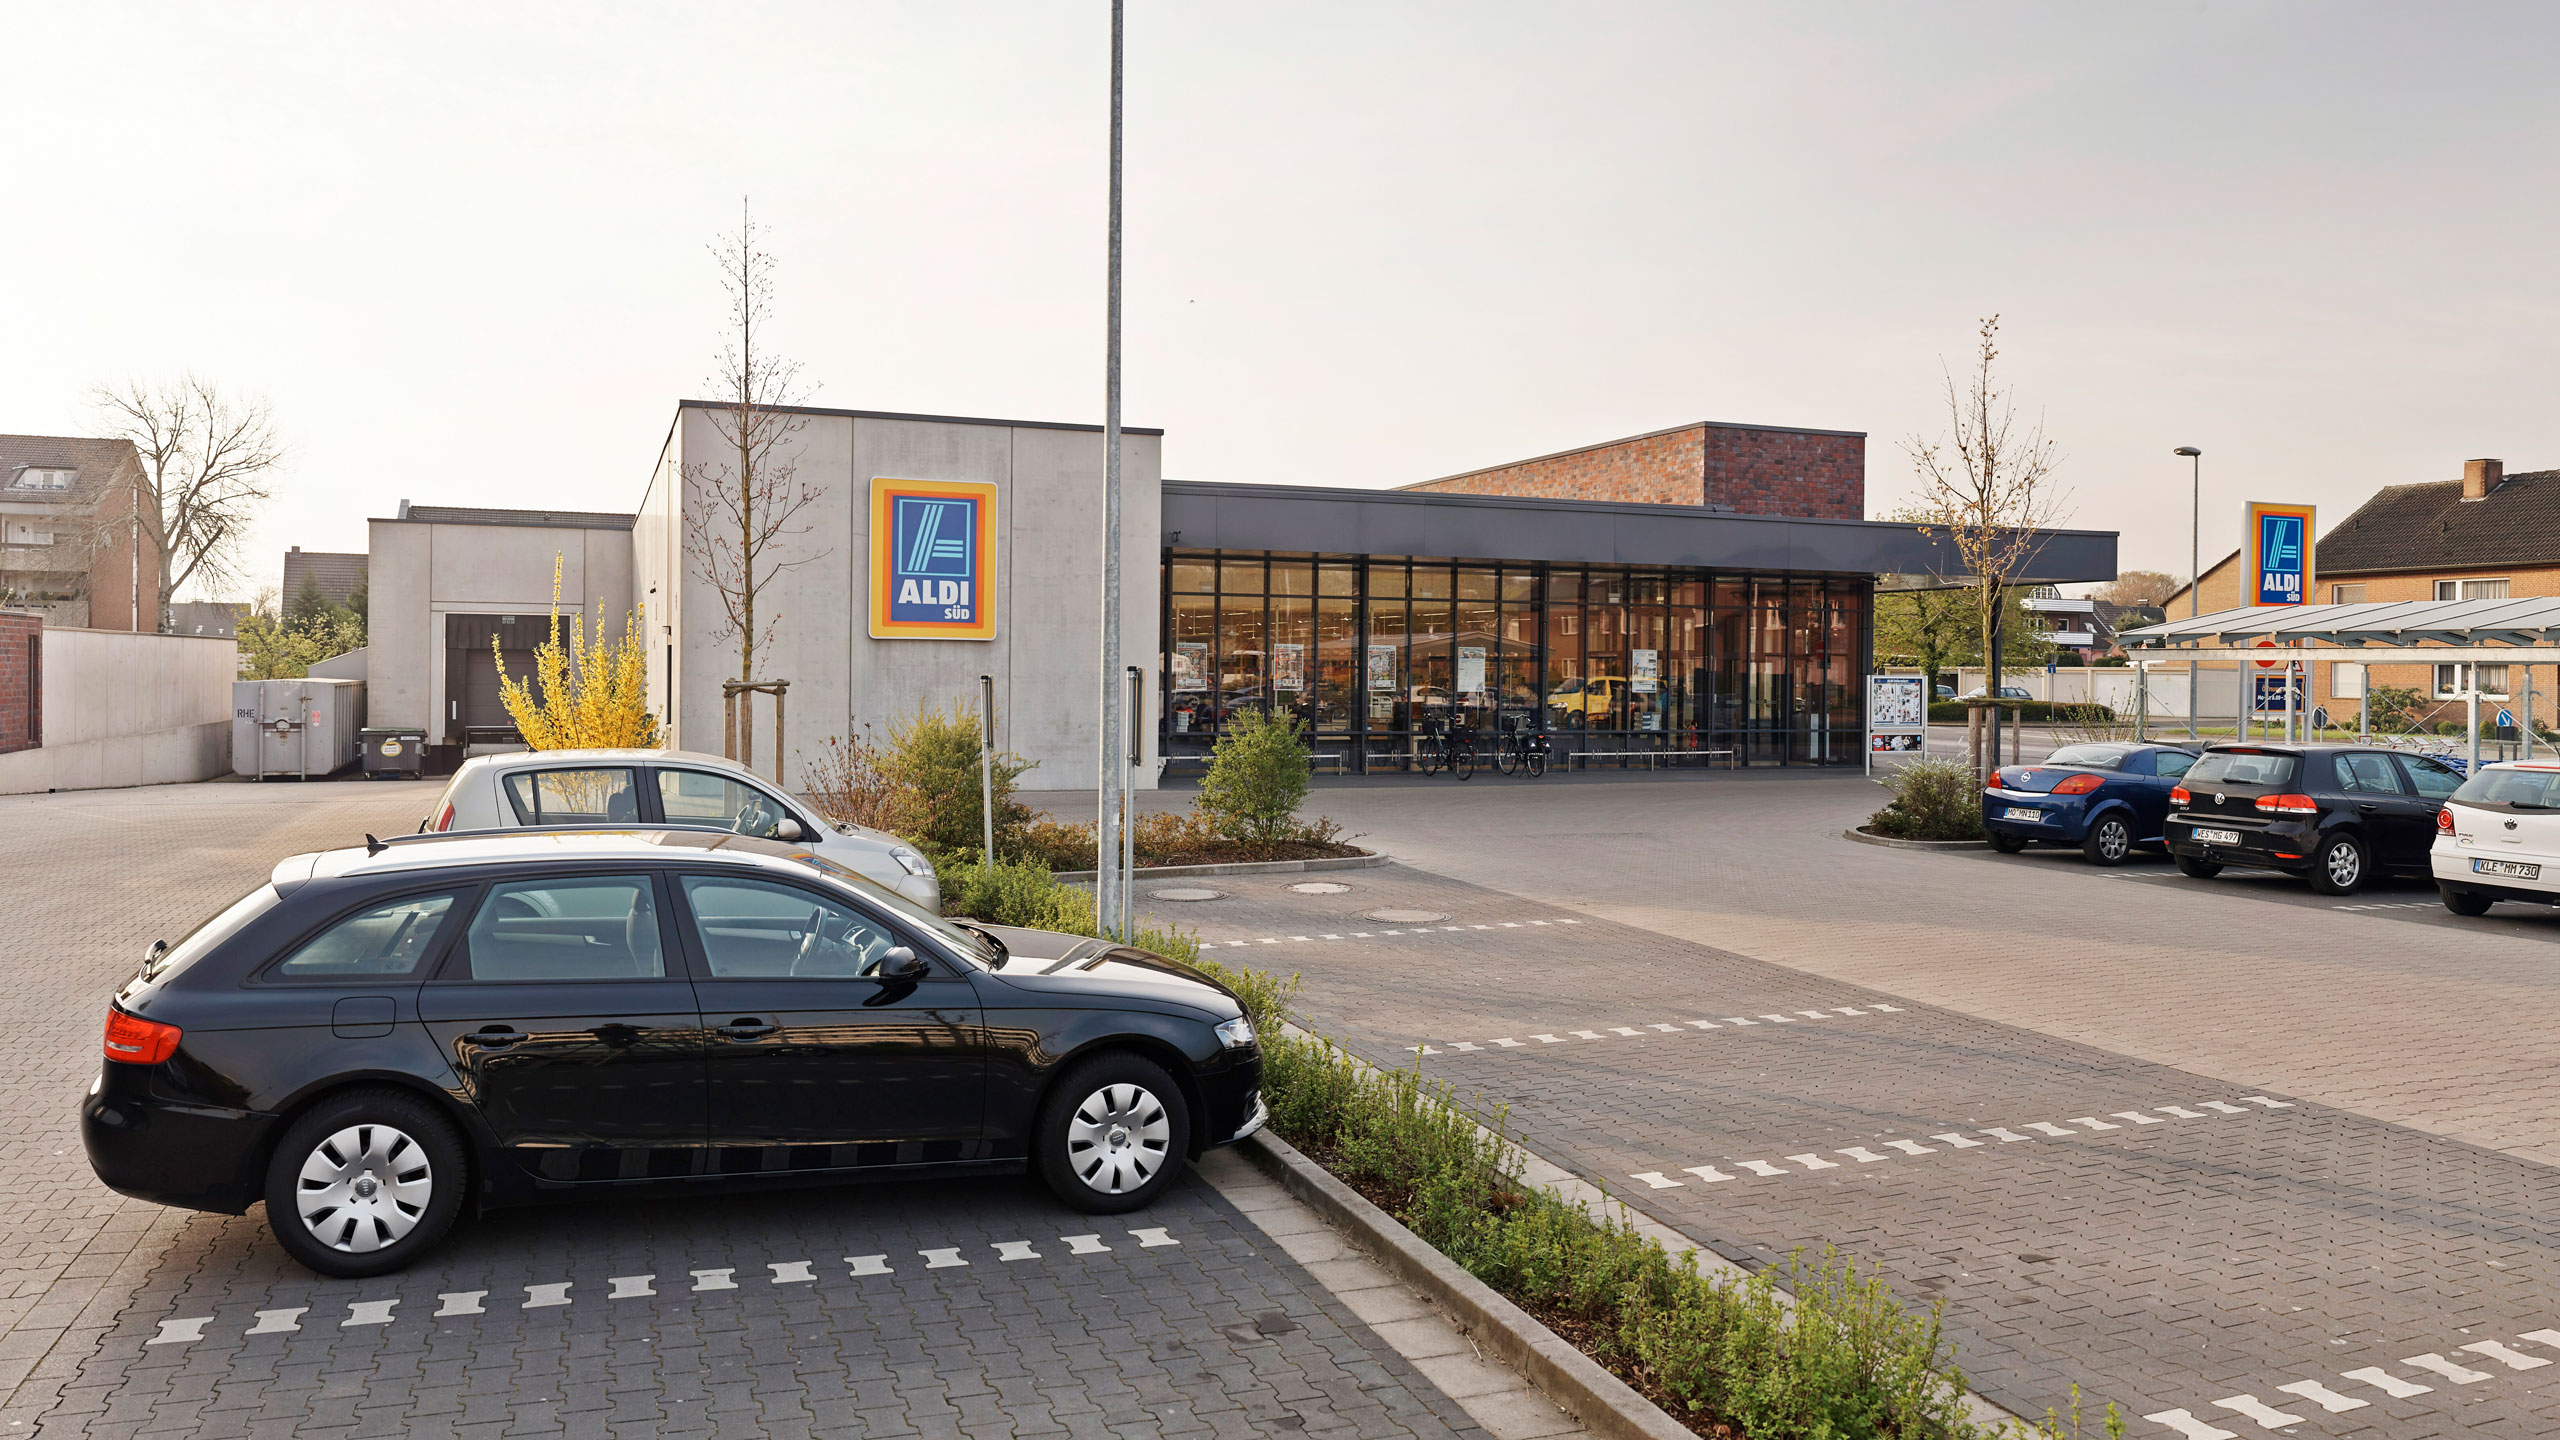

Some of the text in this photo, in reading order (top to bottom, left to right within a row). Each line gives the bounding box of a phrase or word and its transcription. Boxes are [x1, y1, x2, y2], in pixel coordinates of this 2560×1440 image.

[2263, 573, 2300, 592] ALDI
[898, 579, 970, 606] ALDI
[2286, 591, 2300, 602] SÜD
[944, 605, 970, 620] SÜD
[237, 708, 255, 718] RHE
[2197, 829, 2238, 841] WES MG 497
[2480, 861, 2498, 872] KLE
[2504, 863, 2518, 875] MM
[2518, 865, 2537, 877] 730
